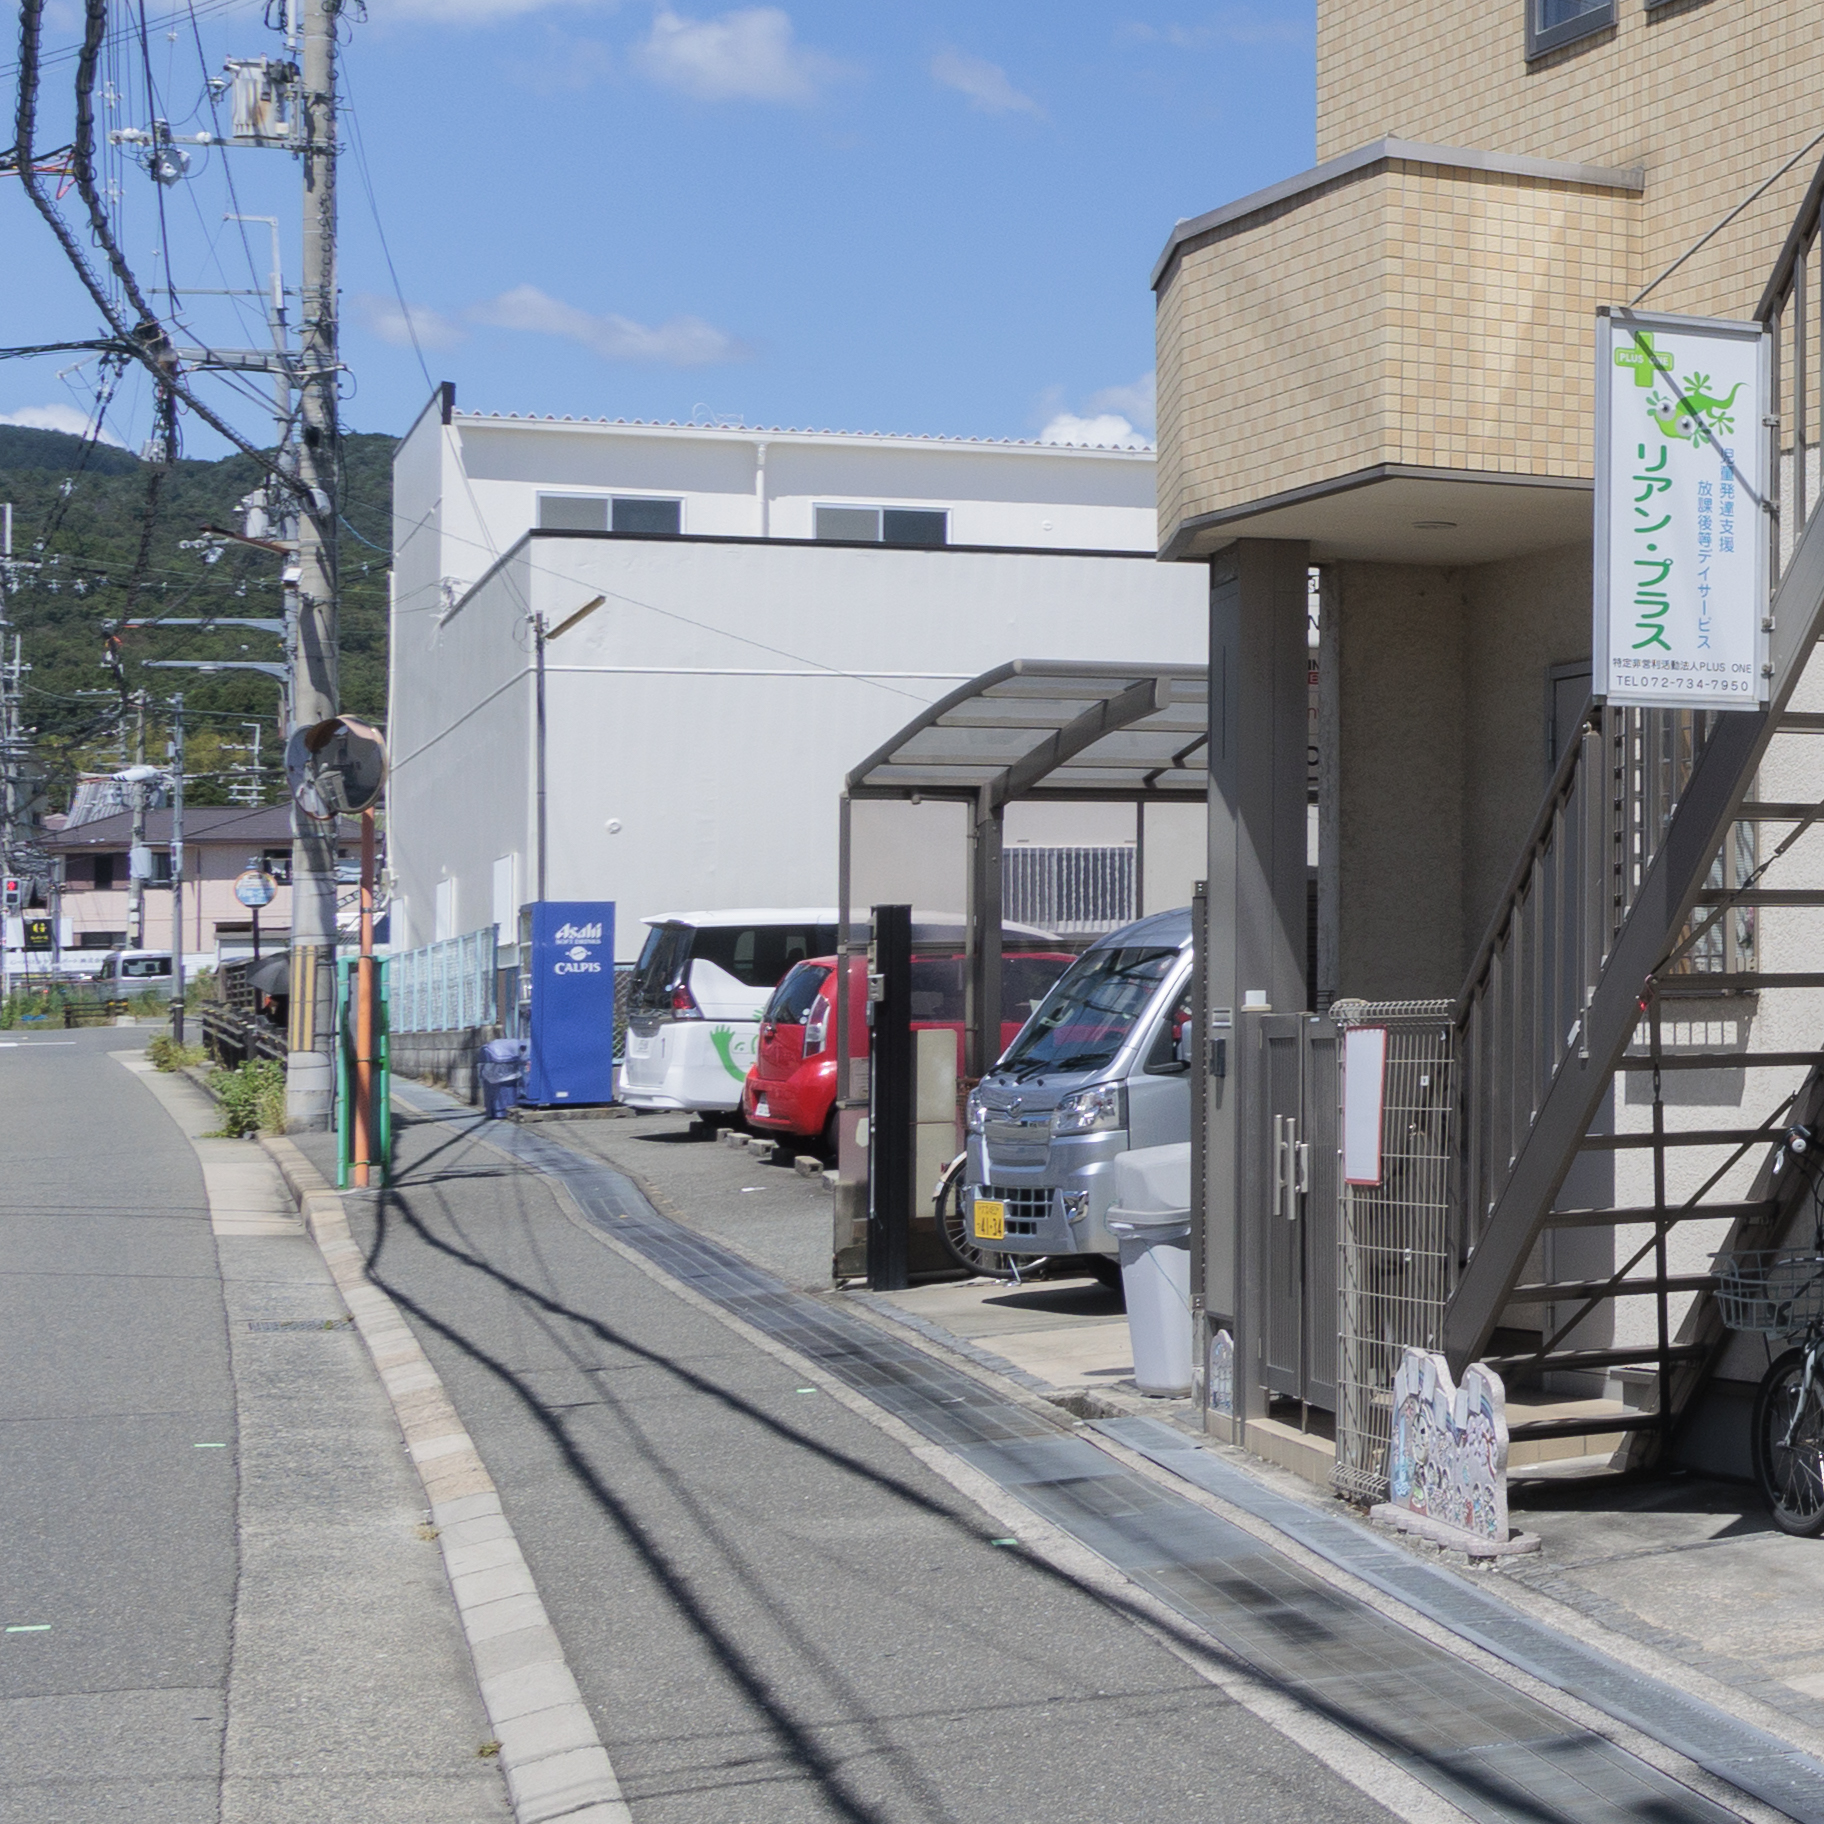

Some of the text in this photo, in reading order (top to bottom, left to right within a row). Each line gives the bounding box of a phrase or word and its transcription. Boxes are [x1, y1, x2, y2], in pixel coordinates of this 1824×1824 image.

[1619, 352, 1669, 366] PLUS ONE
[1719, 447, 1735, 553] 児童発達支援
[1632, 443, 1673, 651] リアン・プラス
[1697, 480, 1713, 649] 放課後等デイサービス
[1731, 663, 1752, 674] ONE
[1616, 675, 1749, 692] TEL072-734-7950
[554, 922, 602, 939] Asahi
[554, 962, 602, 975] CALPIS
